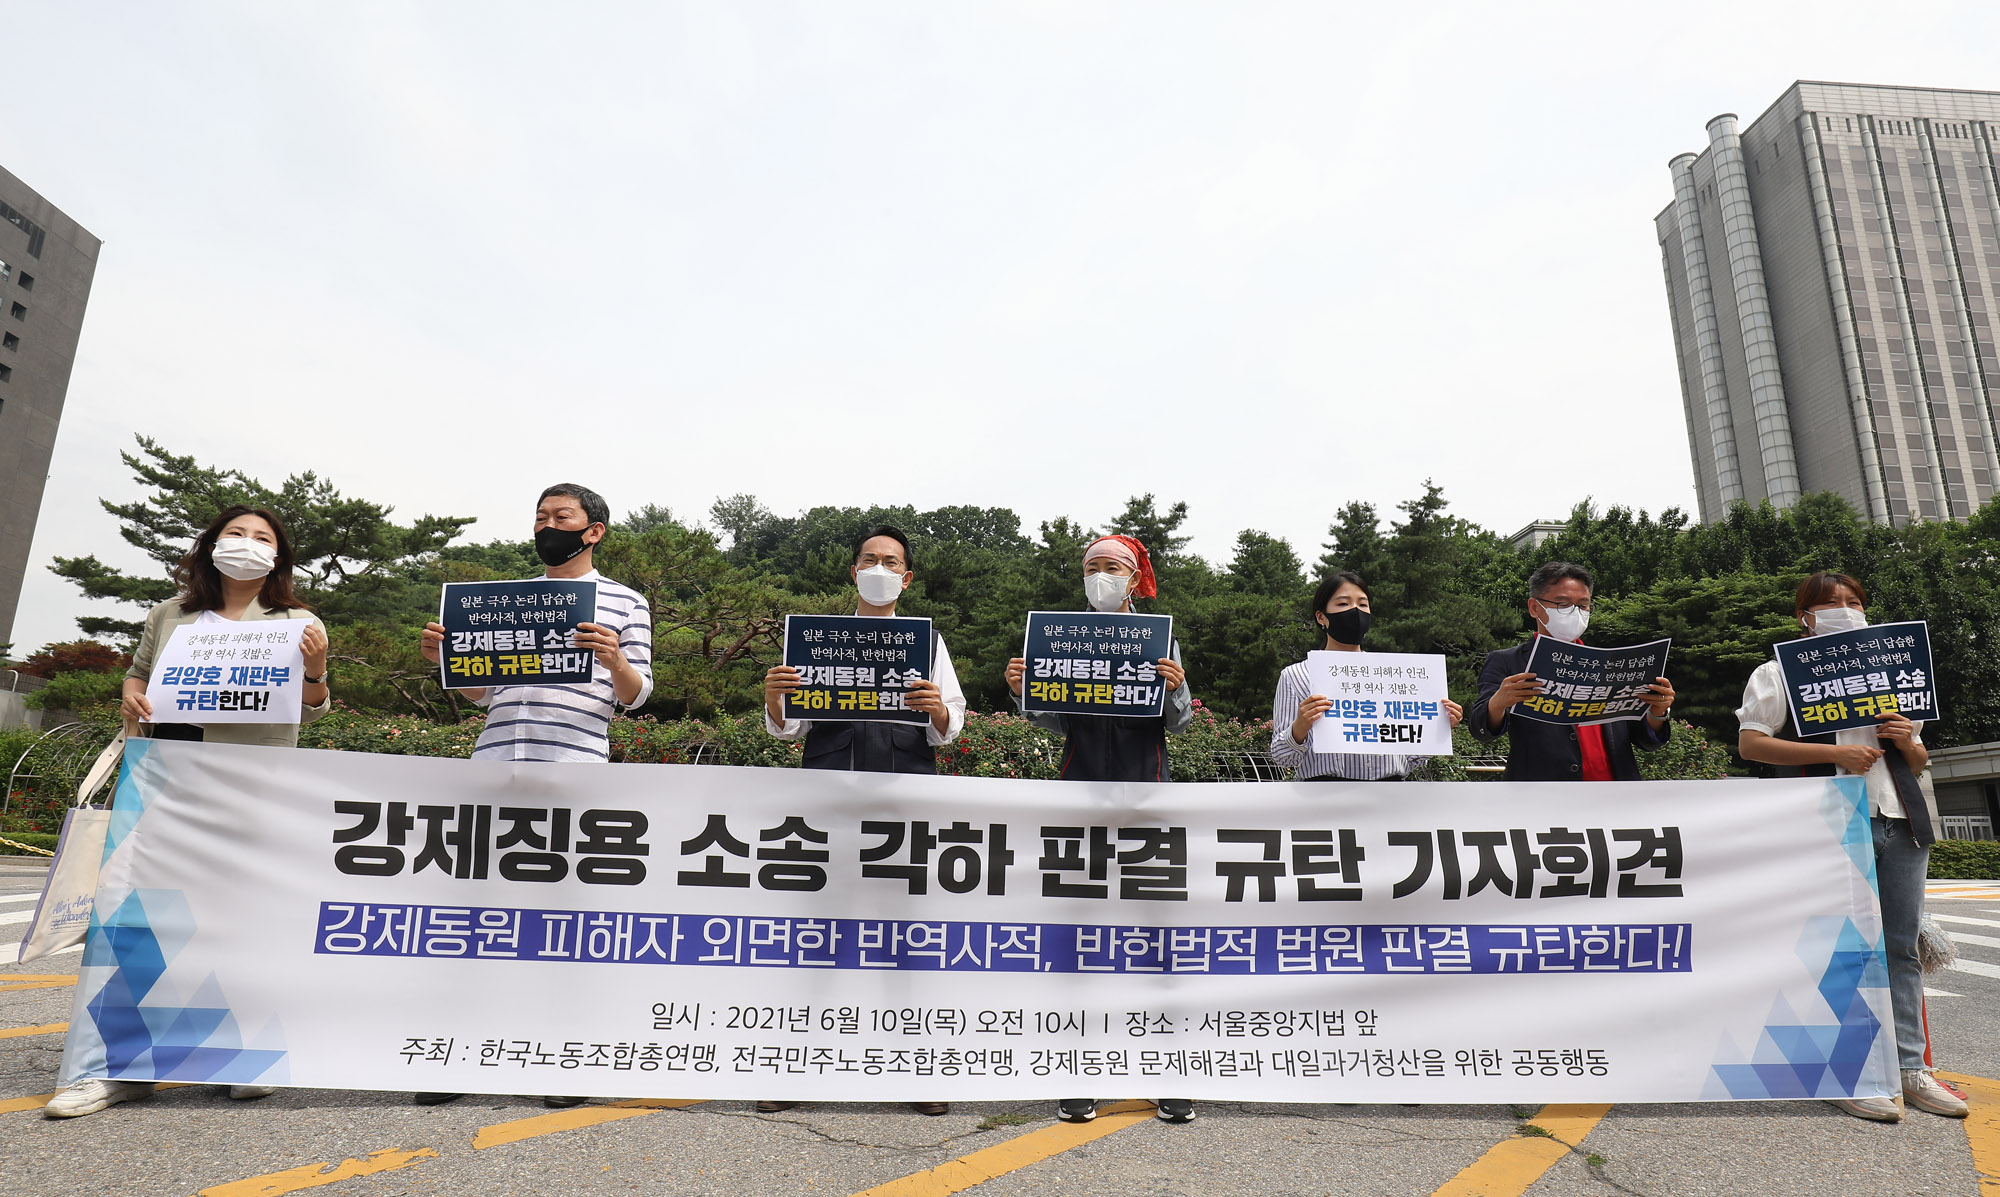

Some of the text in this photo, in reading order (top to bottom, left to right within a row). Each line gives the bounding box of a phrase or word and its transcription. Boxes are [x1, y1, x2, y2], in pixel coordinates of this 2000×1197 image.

[460, 592, 578, 609] 일본 극우 논리 답습한
[468, 610, 567, 626] 반역사적, 반헌법적
[187, 632, 289, 646] 강제동원 피해자 인권,
[451, 629, 536, 653] 강제동원
[803, 629, 916, 645] 일본 극우 논리 답습한
[1043, 624, 1152, 640] 일본 극우 논리 답습한
[190, 648, 272, 660] 투쟁 역사 짓밟은
[811, 648, 907, 662] 반역사적, 반헌법적
[1050, 641, 1142, 656] 반역사적, 반헌법적
[1797, 635, 1915, 664] 일본 극우 논리 답습한
[449, 652, 589, 677] 각하 규탄한다!
[1033, 658, 1157, 682] 강제동원 소송
[1551, 651, 1656, 670] 일본 극우 논리 답습한
[1811, 652, 1912, 677] 반역사적, 반헌법적
[162, 666, 290, 686] 김양호 재판부
[794, 665, 922, 688] 강제동원 소송
[1328, 665, 1429, 680] 강제동원 피해자 인권,
[1555, 667, 1646, 682] 반역사적, 반헌법적
[1030, 682, 1160, 706] 각하 규탄한다!
[1341, 682, 1419, 695] 투쟁 역사 짓밟은
[1798, 668, 1926, 703] 강제동원 소송
[176, 690, 270, 711] 규탄한다!
[790, 689, 833, 710] 각하
[1384, 700, 1439, 720] 재판부
[1523, 696, 1646, 718] 각하 규탄한다!
[1801, 690, 1931, 724] 각하 규탄한다!
[1343, 723, 1423, 744] 규탄한다!
[332, 800, 1684, 903] 강제징용 소송 각하 판결 규탄 기자회견
[324, 904, 1685, 973] 강제동원 피해자 외면한 반역사적, 반헌법적 법원 판결 규탄한다!
[651, 1002, 700, 1031] 일시
[726, 1005, 810, 1033] 2021년
[820, 1006, 860, 1035] 6월
[870, 1007, 966, 1036] 10일(목)
[975, 1008, 1023, 1036] 오전
[1034, 1010, 1086, 1037] 10시
[1125, 1011, 1175, 1037] 장소
[1199, 1009, 1346, 1037] 서울중앙지법
[1354, 1009, 1378, 1036] 앞
[400, 1037, 454, 1066] 주최
[479, 1039, 720, 1073] 한국노동조합총연맹,
[732, 1045, 1019, 1077] 전국민주노동조합총연맹,
[1030, 1049, 1129, 1076] 강제동원
[1139, 1049, 1264, 1078] 문제해결과
[1272, 1048, 1446, 1078] 대일과거청산을
[1454, 1048, 1503, 1077] 위한
[1511, 1048, 1609, 1077] 공동행동
